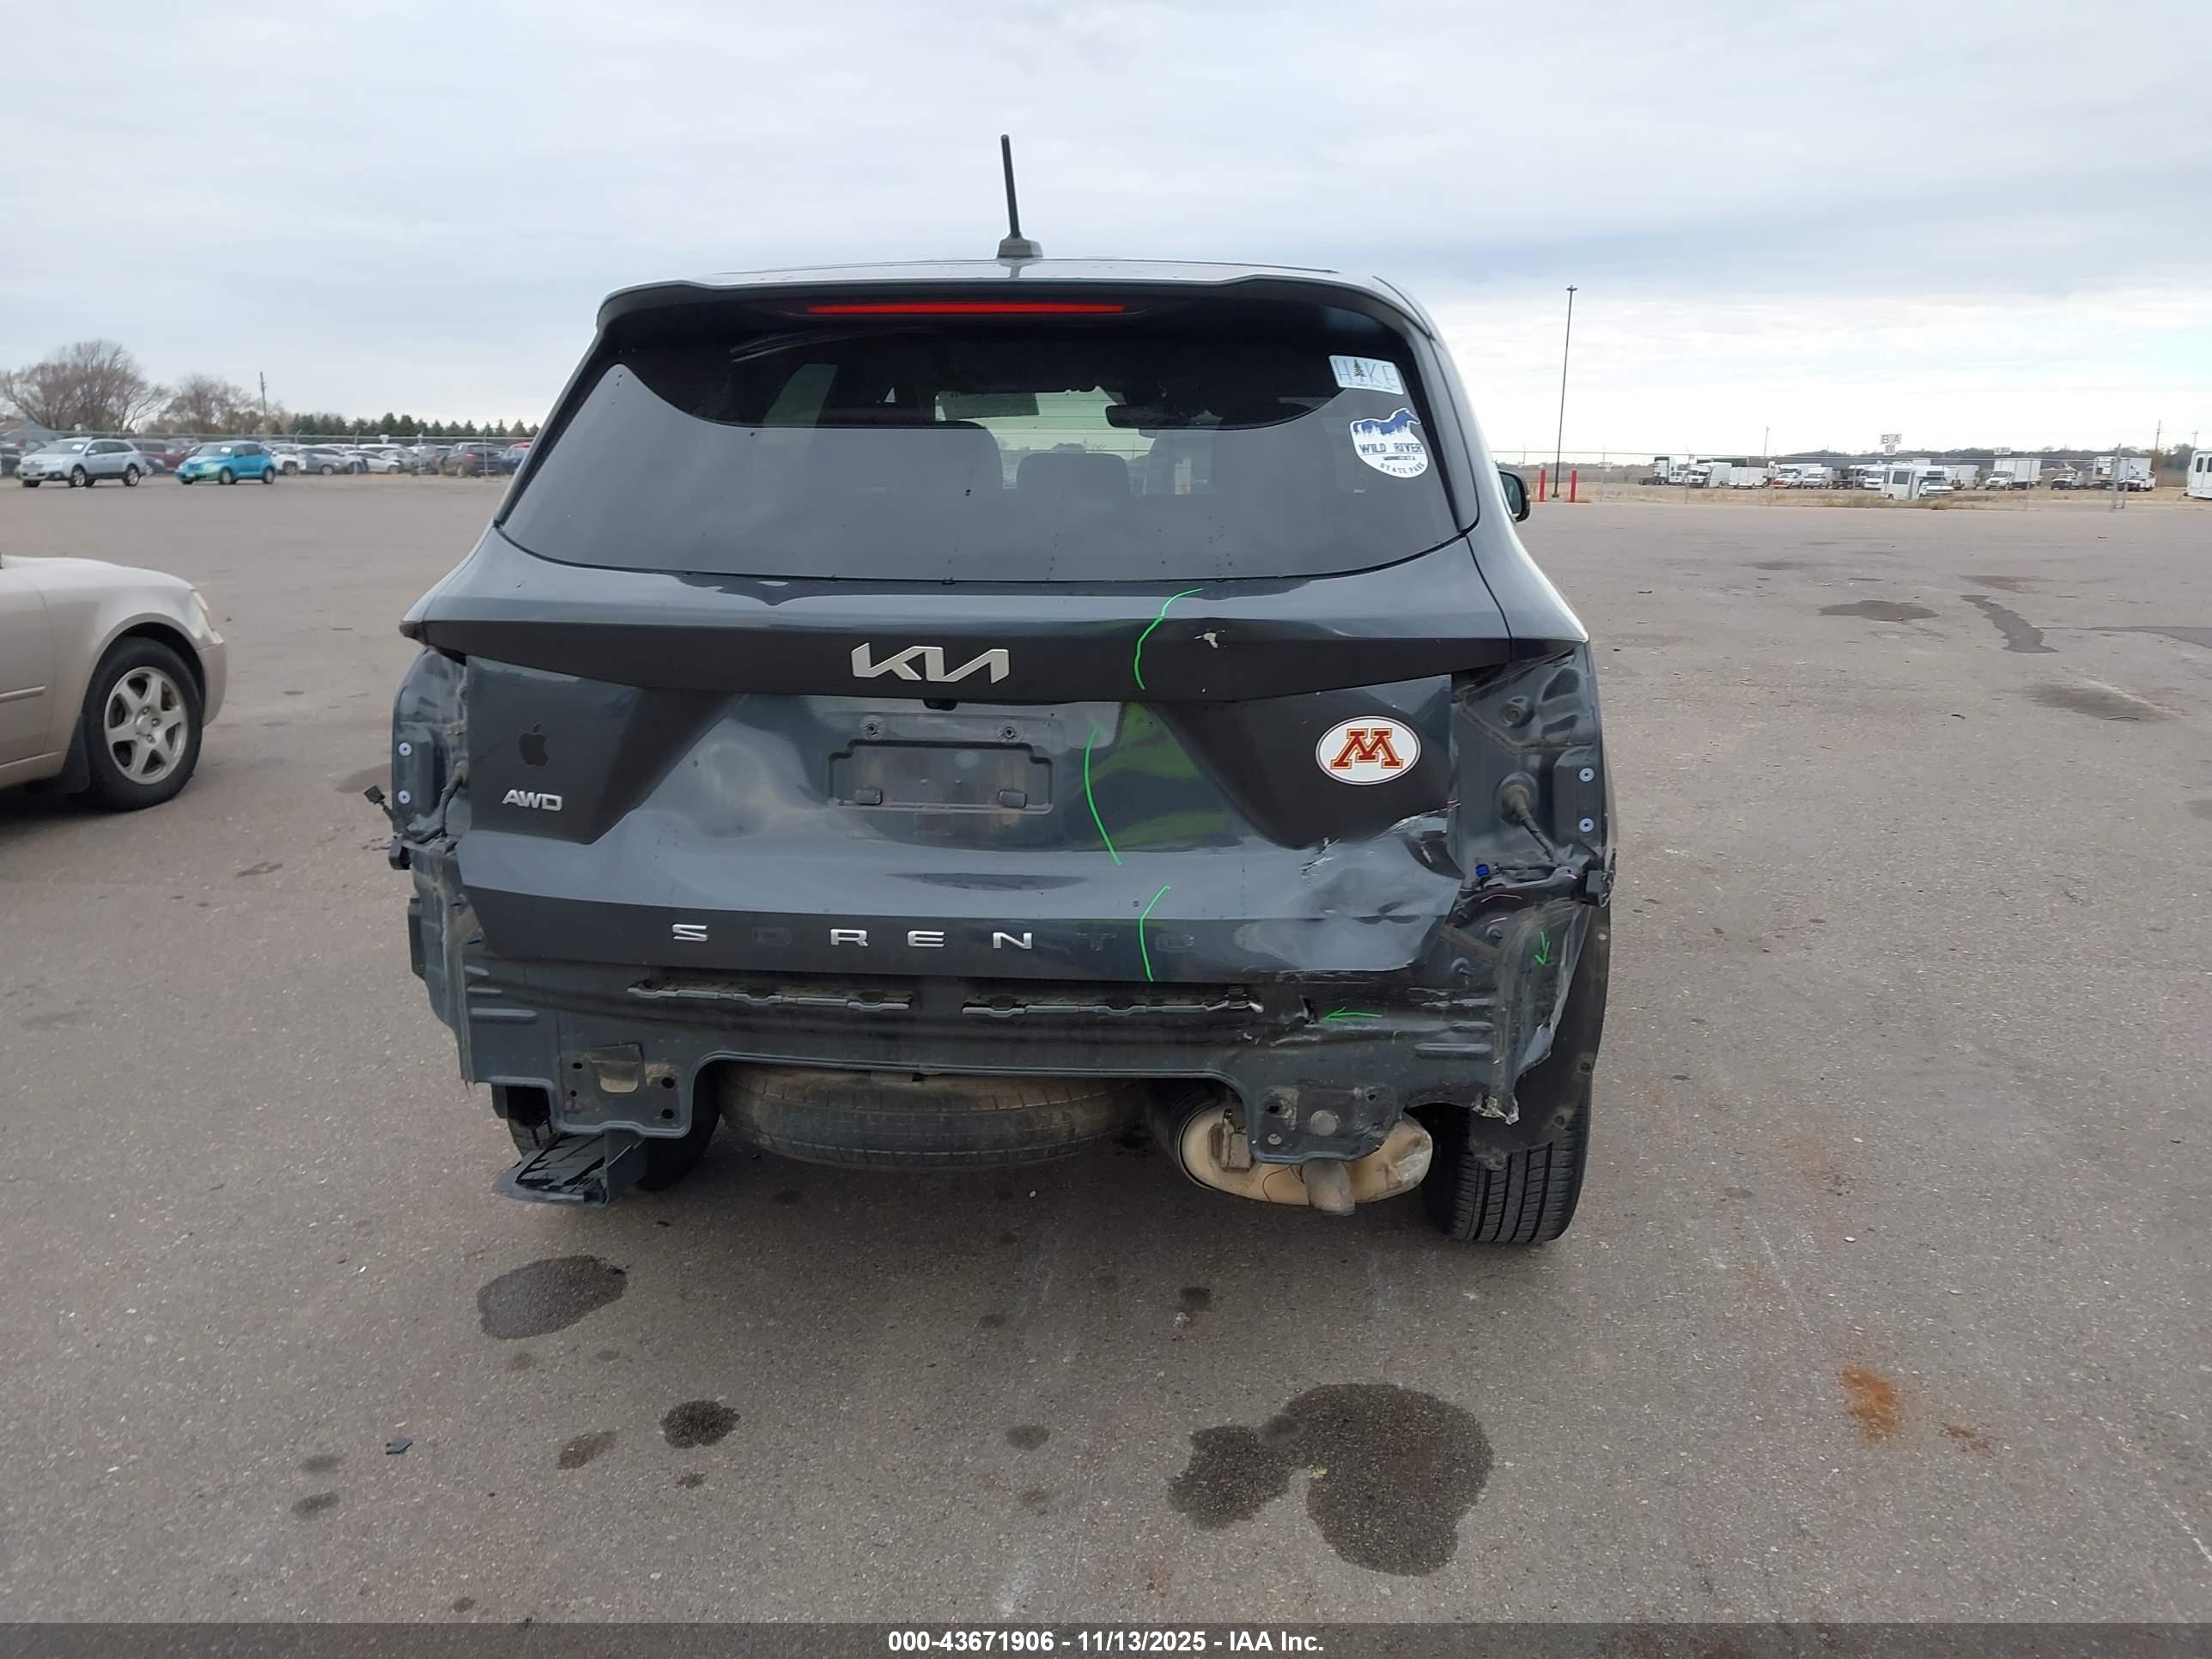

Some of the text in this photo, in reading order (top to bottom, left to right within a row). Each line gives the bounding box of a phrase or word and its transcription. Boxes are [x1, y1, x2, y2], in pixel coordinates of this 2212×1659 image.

[1358, 443, 1422, 453] WILD RIVER
[851, 642, 1010, 684] KIA
[1330, 728, 1404, 769] M
[501, 789, 562, 811] AWD
